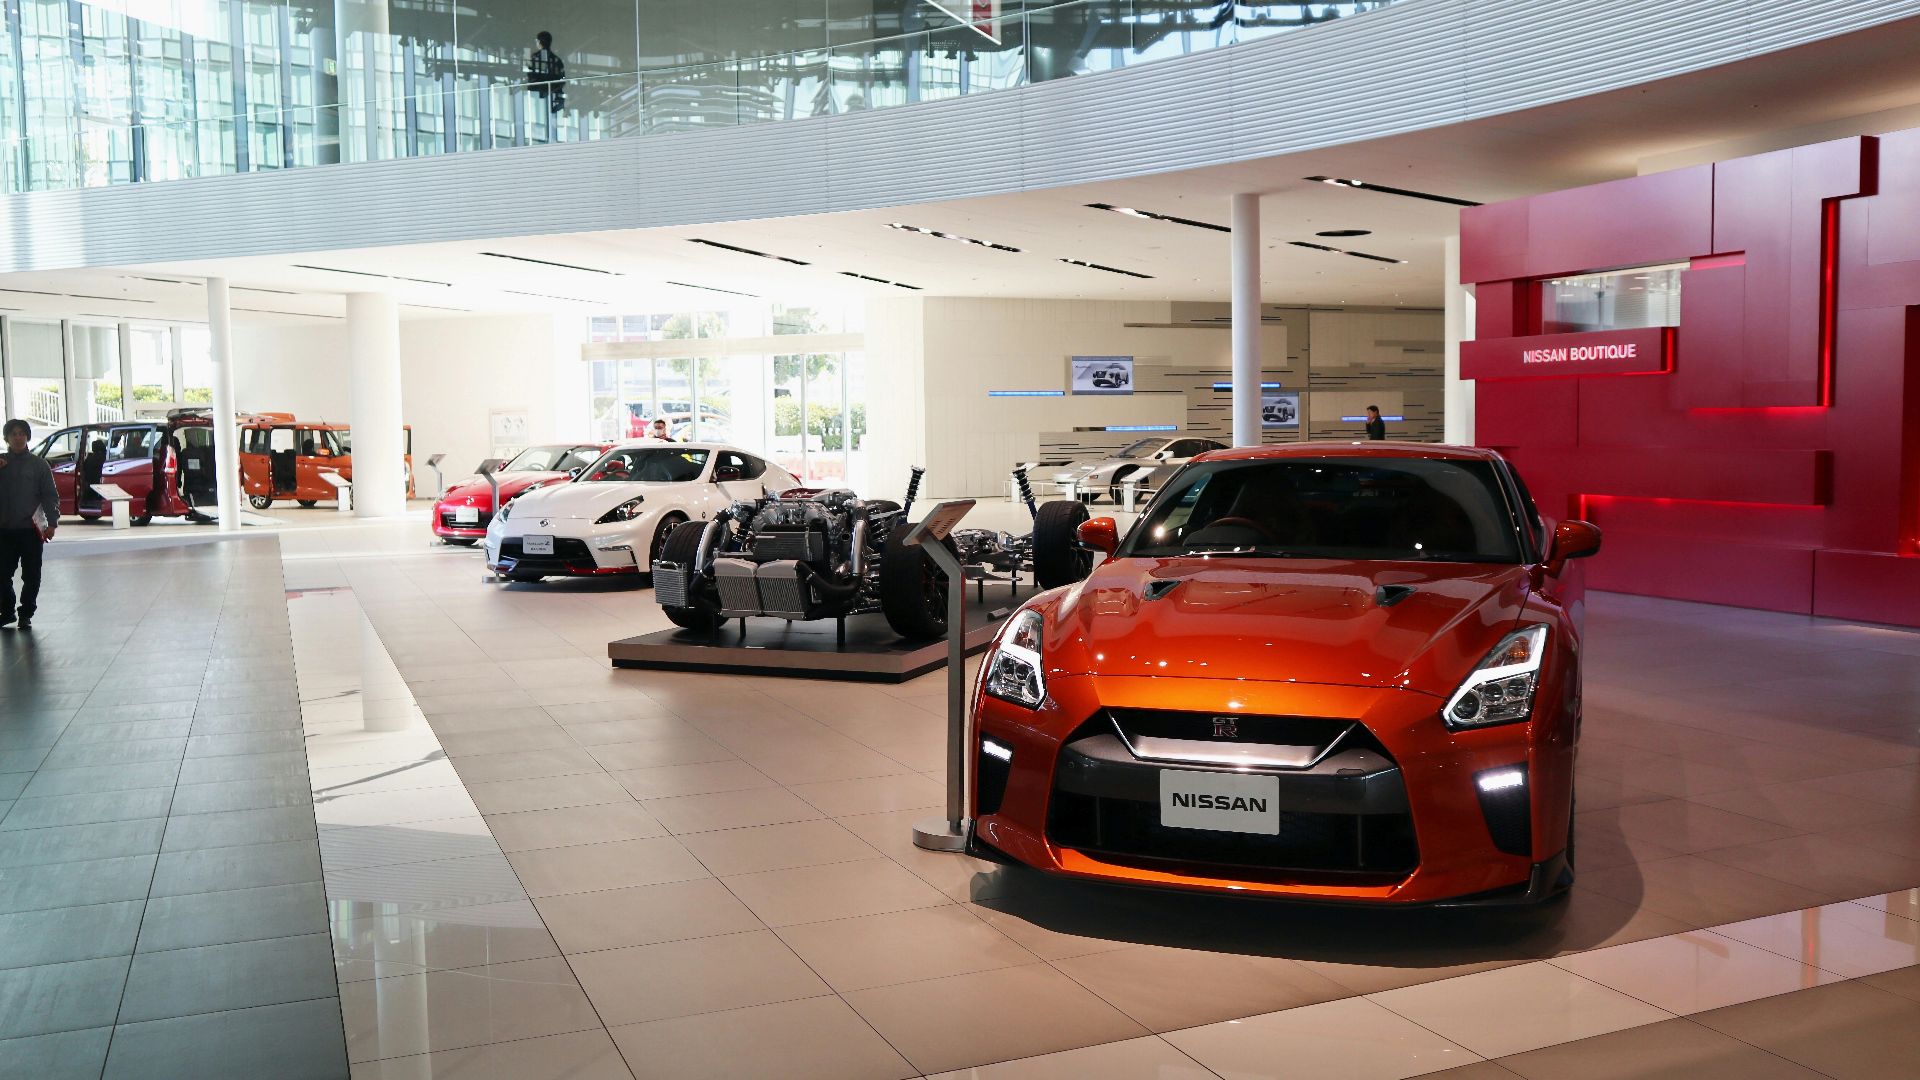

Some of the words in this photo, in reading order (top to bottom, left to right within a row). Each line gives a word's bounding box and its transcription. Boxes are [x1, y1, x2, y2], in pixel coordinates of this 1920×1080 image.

[1523, 348, 1567, 364] NISSAN
[1570, 343, 1636, 361] BOUTIQUE
[1172, 792, 1267, 813] NISSAN
